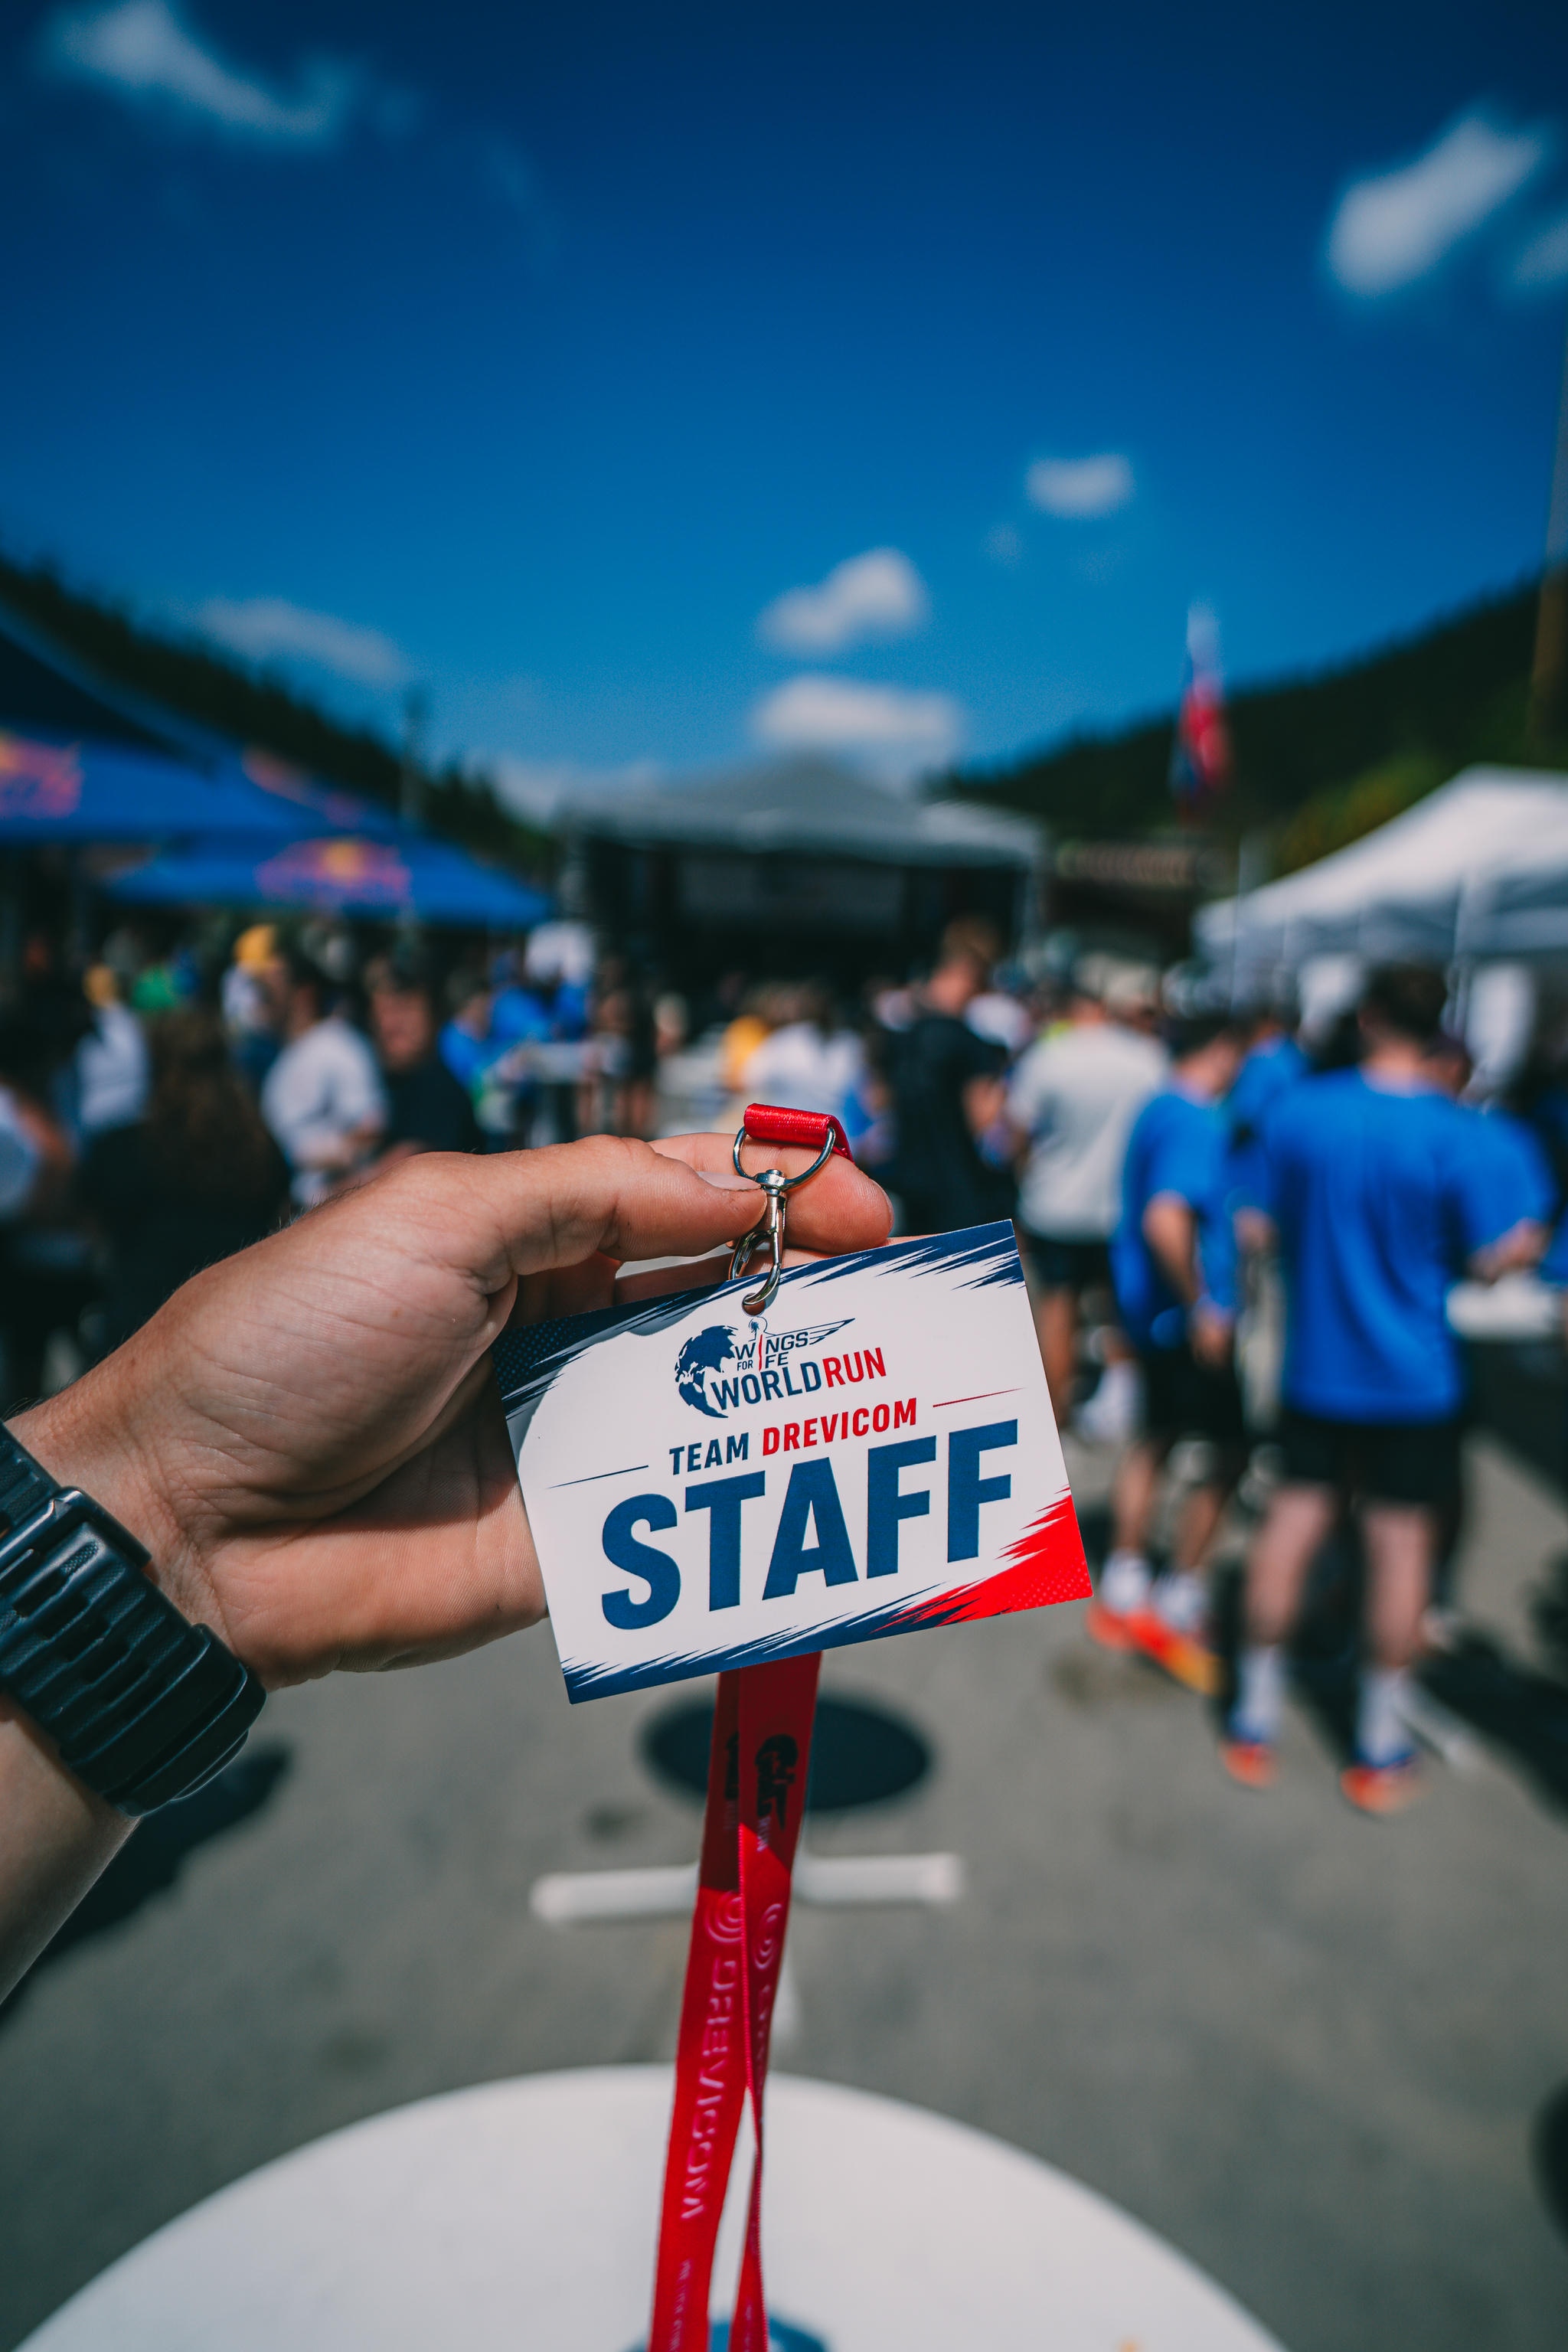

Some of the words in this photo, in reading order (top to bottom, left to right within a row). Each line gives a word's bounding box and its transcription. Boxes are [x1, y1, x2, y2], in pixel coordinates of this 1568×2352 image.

[734, 1331, 808, 1361] WINGS
[737, 1359, 753, 1371] FOR
[669, 1432, 750, 1475] TEAM
[763, 1398, 916, 1456] DREVICOM
[601, 1419, 1018, 1631] STAFF
